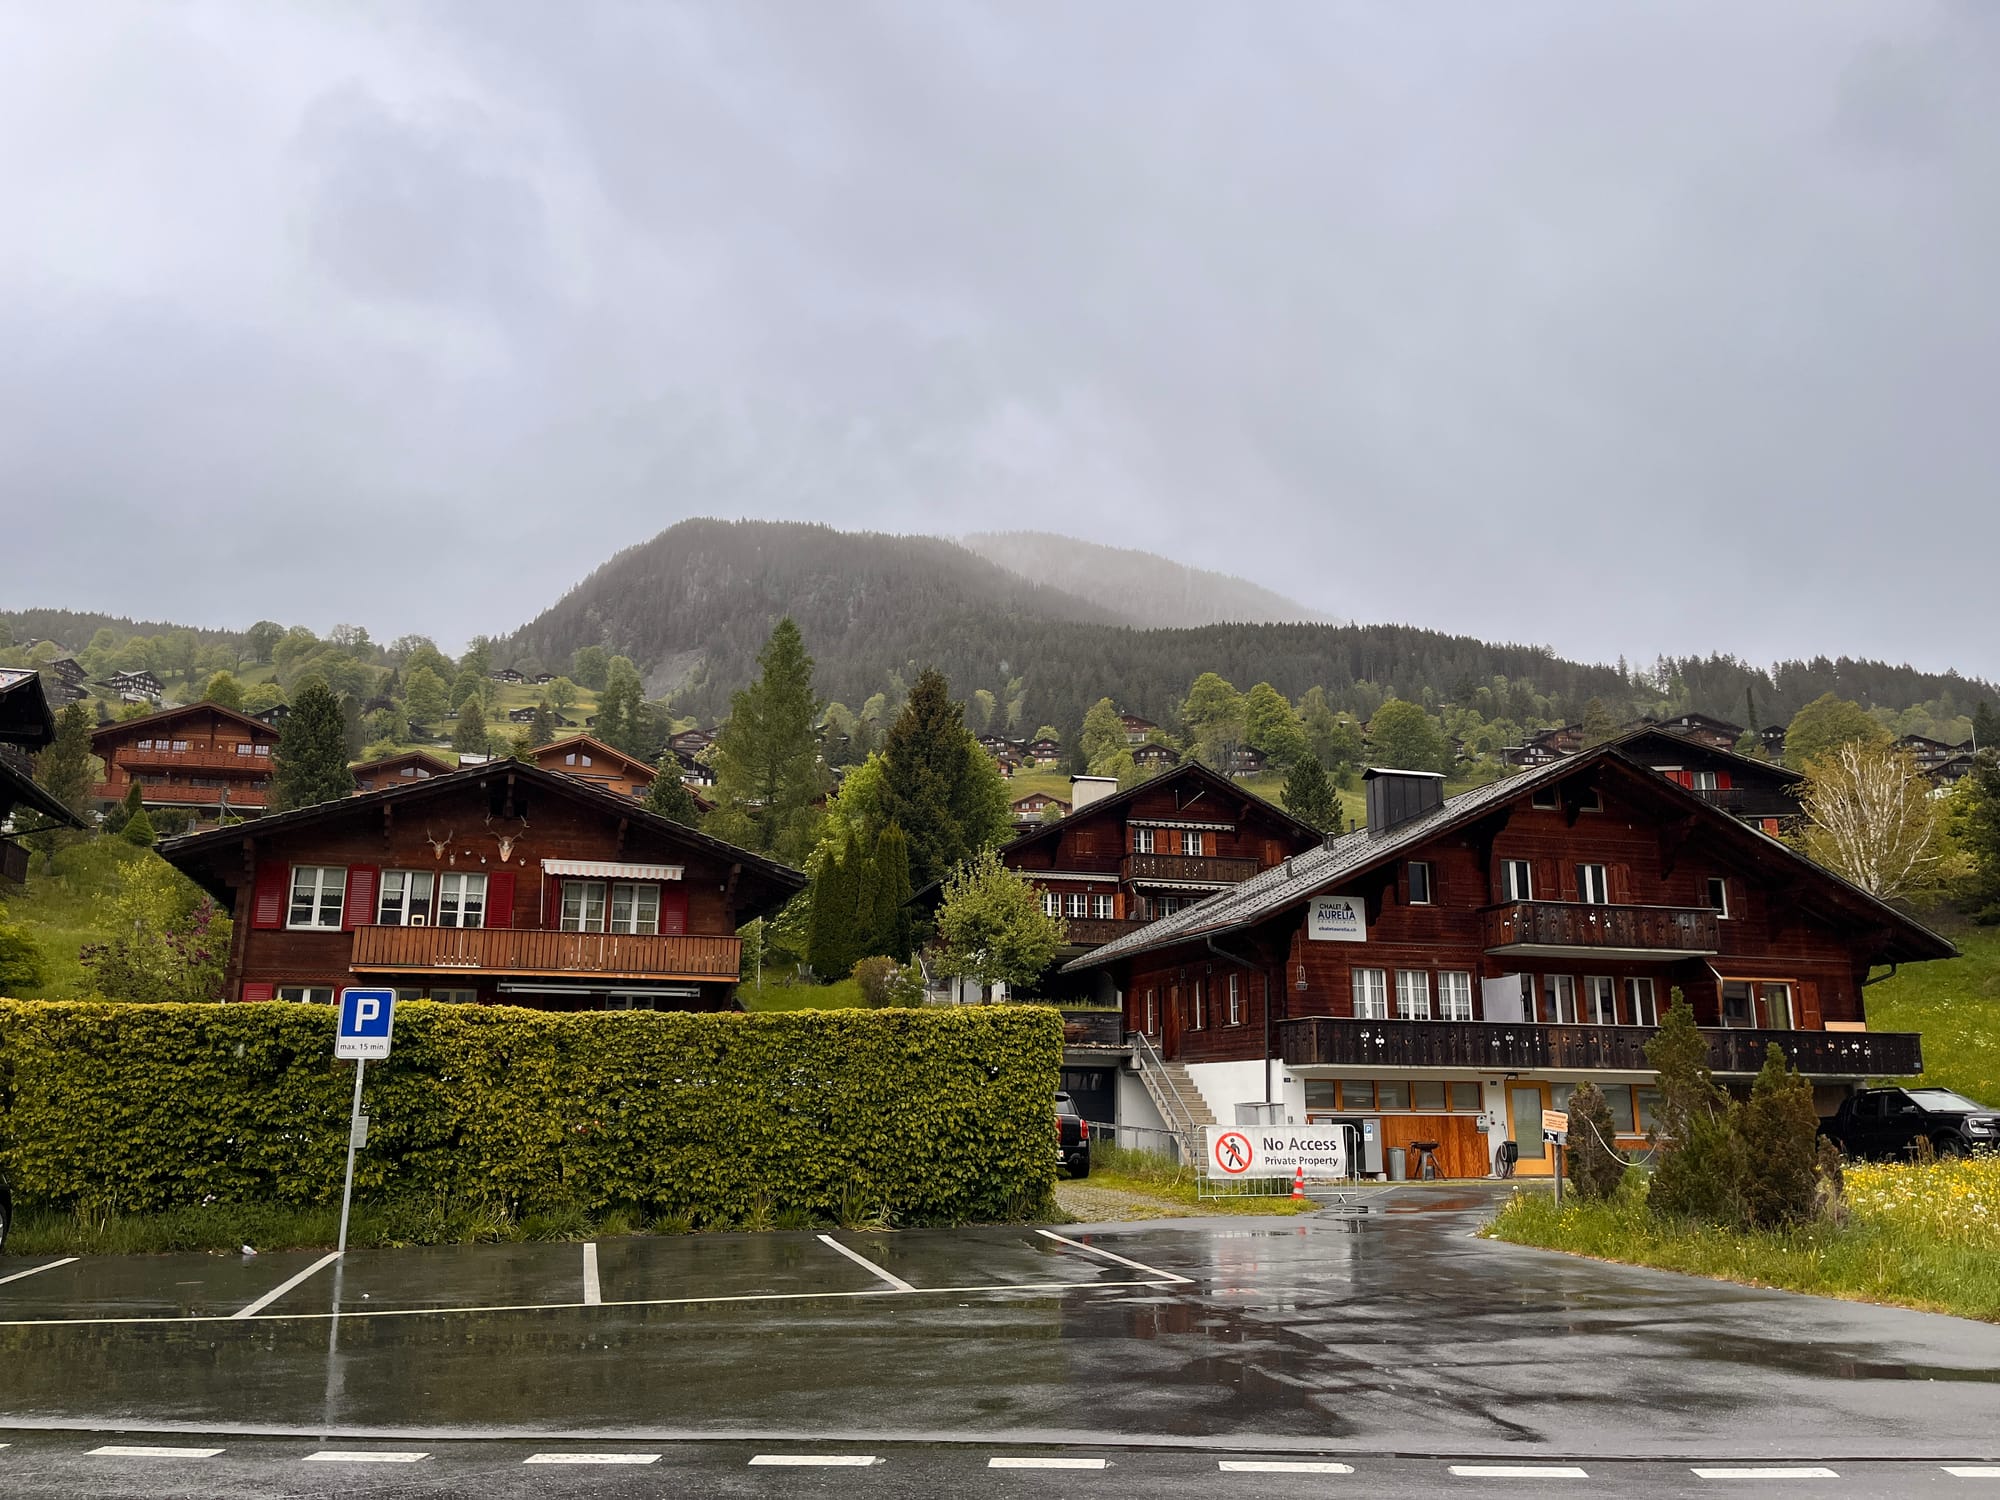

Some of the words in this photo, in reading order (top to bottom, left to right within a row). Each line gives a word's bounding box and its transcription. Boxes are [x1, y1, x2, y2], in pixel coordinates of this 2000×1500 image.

[1317, 910, 1356, 920] AURELIA
[354, 998, 380, 1032] P
[1263, 1137, 1284, 1151] No
[1289, 1137, 1337, 1151] Access
[1265, 1156, 1297, 1165] Private
[1299, 1156, 1339, 1167] Property
